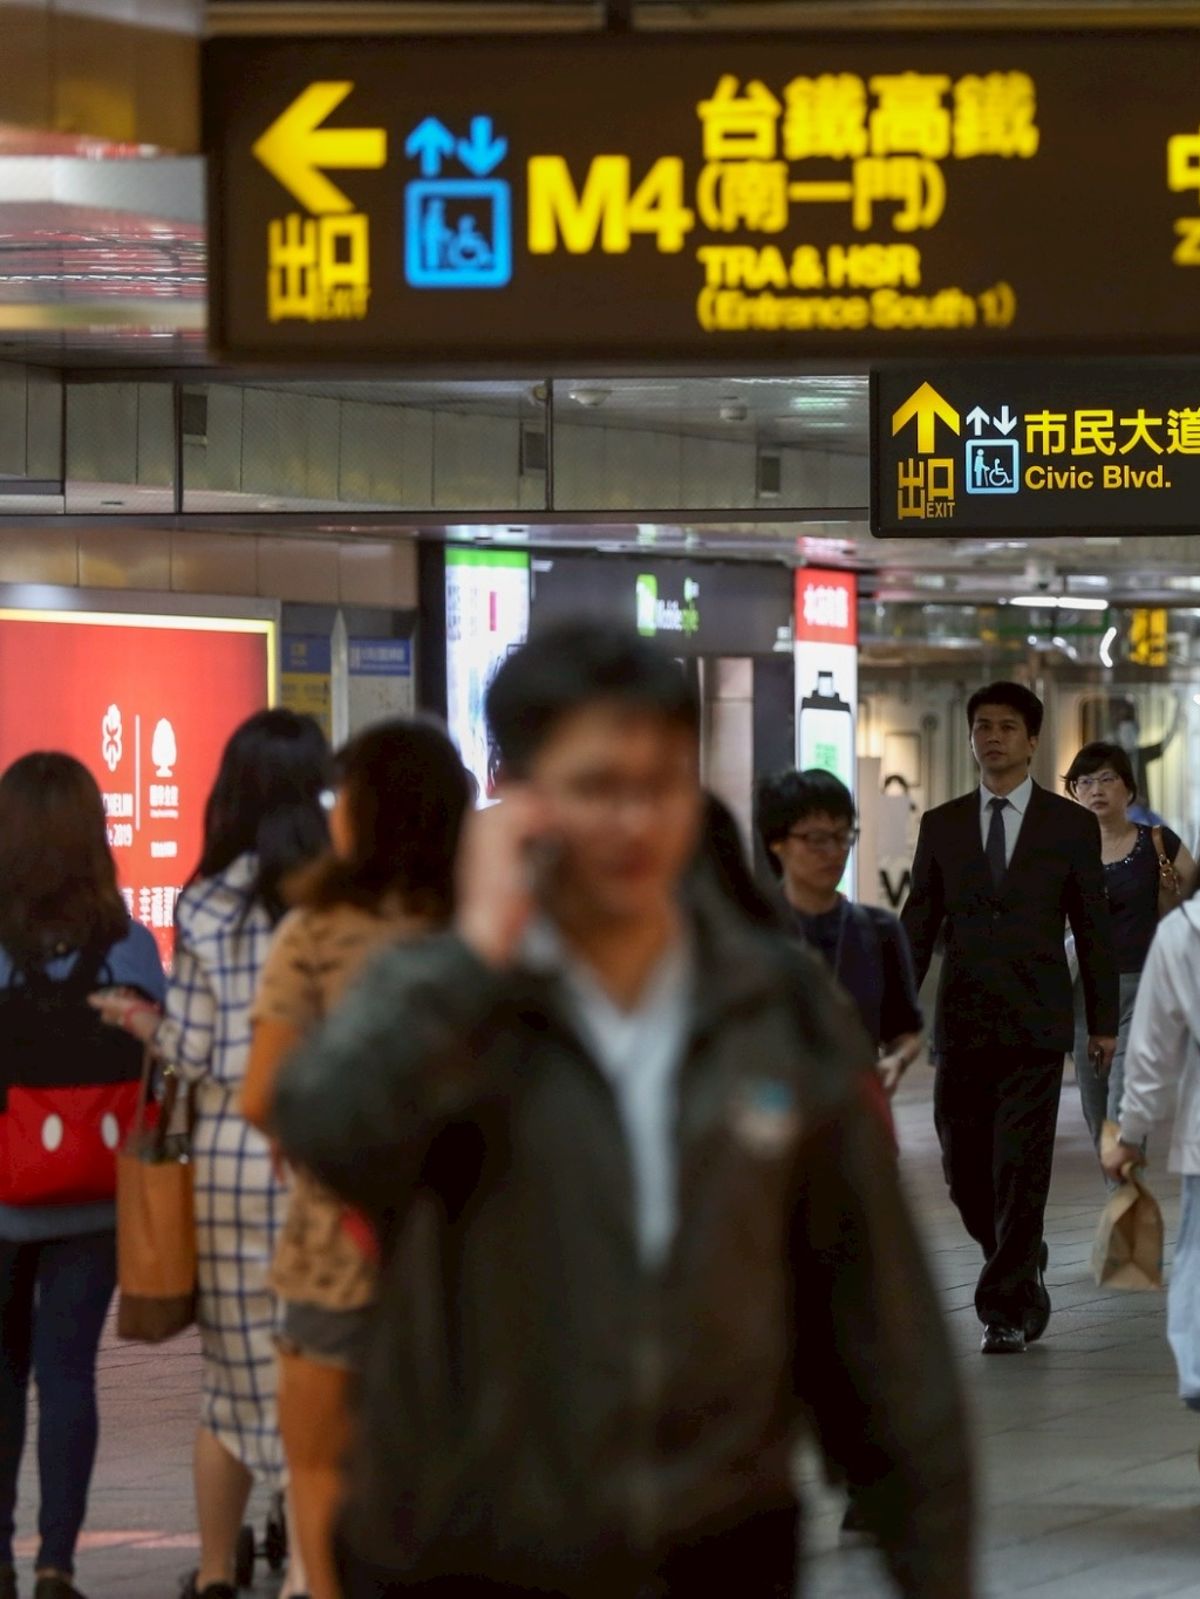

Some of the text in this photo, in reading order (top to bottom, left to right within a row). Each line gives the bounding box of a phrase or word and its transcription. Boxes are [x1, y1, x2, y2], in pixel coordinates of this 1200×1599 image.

[698, 72, 1038, 158] 台鐵高鐵
[528, 156, 694, 253] M4
[268, 214, 369, 320] 出口
[698, 245, 920, 289] TRA & HSR
[899, 458, 955, 518] 出口
[1025, 465, 1171, 489] Civic Blvd.
[927, 502, 955, 517] EXIT
